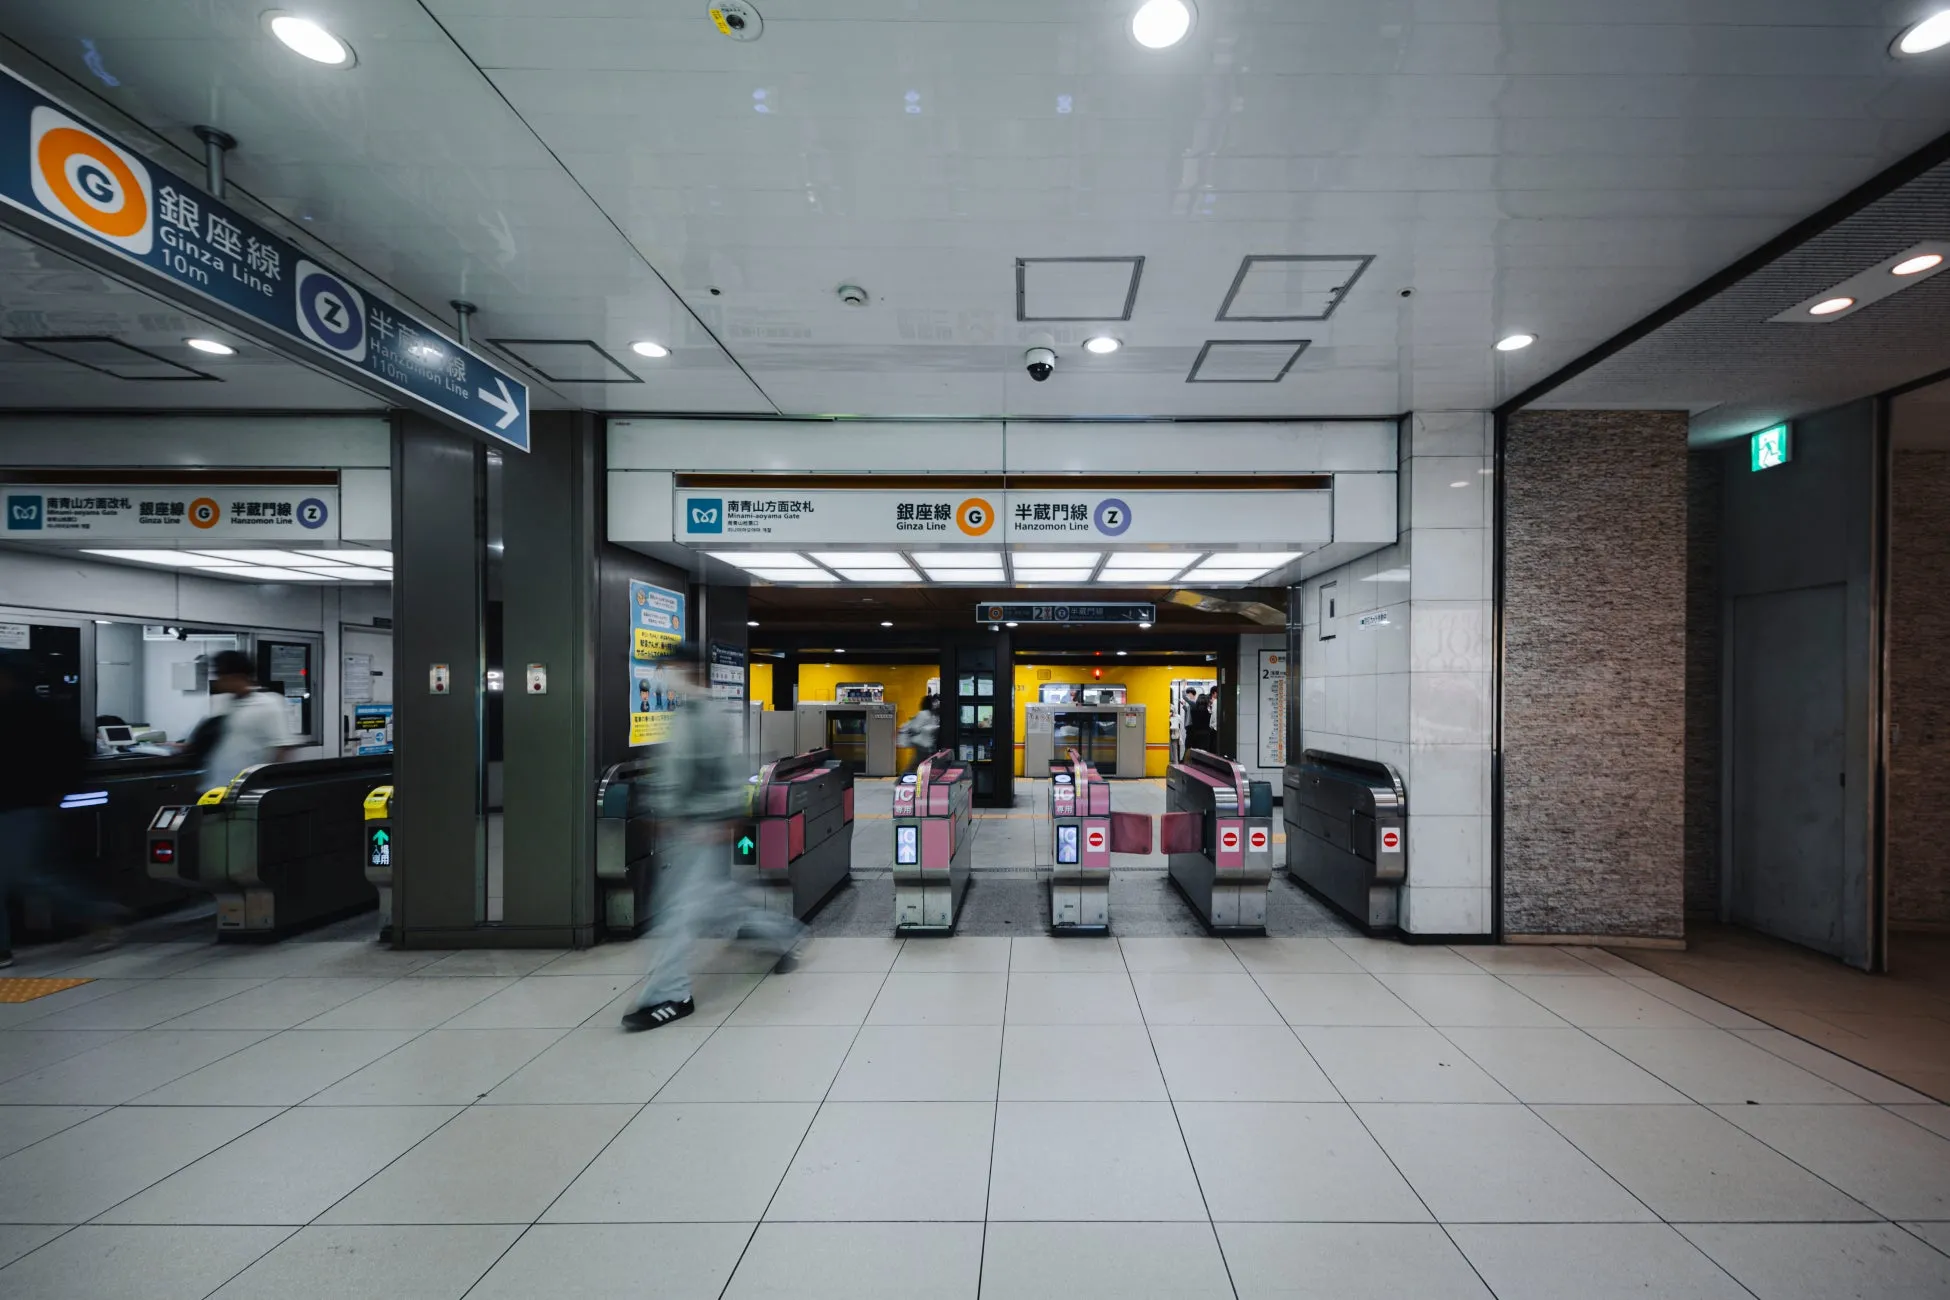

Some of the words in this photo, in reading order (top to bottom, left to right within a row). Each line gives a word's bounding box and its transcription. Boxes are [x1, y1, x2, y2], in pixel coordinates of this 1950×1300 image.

[77, 164, 114, 203] G
[158, 185, 280, 280] 銀座線
[160, 226, 224, 272] Ginza
[232, 262, 273, 297] Line
[162, 248, 208, 285] 10m
[323, 297, 342, 328] Z
[372, 355, 408, 384] 110m
[445, 376, 469, 399] Line
[139, 502, 185, 517] 銀座線
[198, 508, 211, 519] G
[231, 502, 292, 517] 半蔵門線
[307, 508, 317, 519] Z
[727, 500, 814, 512] 南青山方面改札
[896, 503, 952, 521] 銀座線
[968, 510, 982, 524] G
[1015, 503, 1089, 521] 半蔵門線
[1107, 510, 1119, 524] Z
[727, 512, 782, 520] Minami-aoyama
[896, 522, 924, 531] Ginza
[926, 522, 946, 531] Line
[1014, 522, 1066, 531] Hanzomon
[1069, 522, 1089, 531] Line
[1035, 607, 1043, 620] 2
[1262, 669, 1269, 679] 2
[895, 786, 914, 802] IC
[1054, 786, 1074, 802] IC
[1056, 805, 1073, 814] 専用
